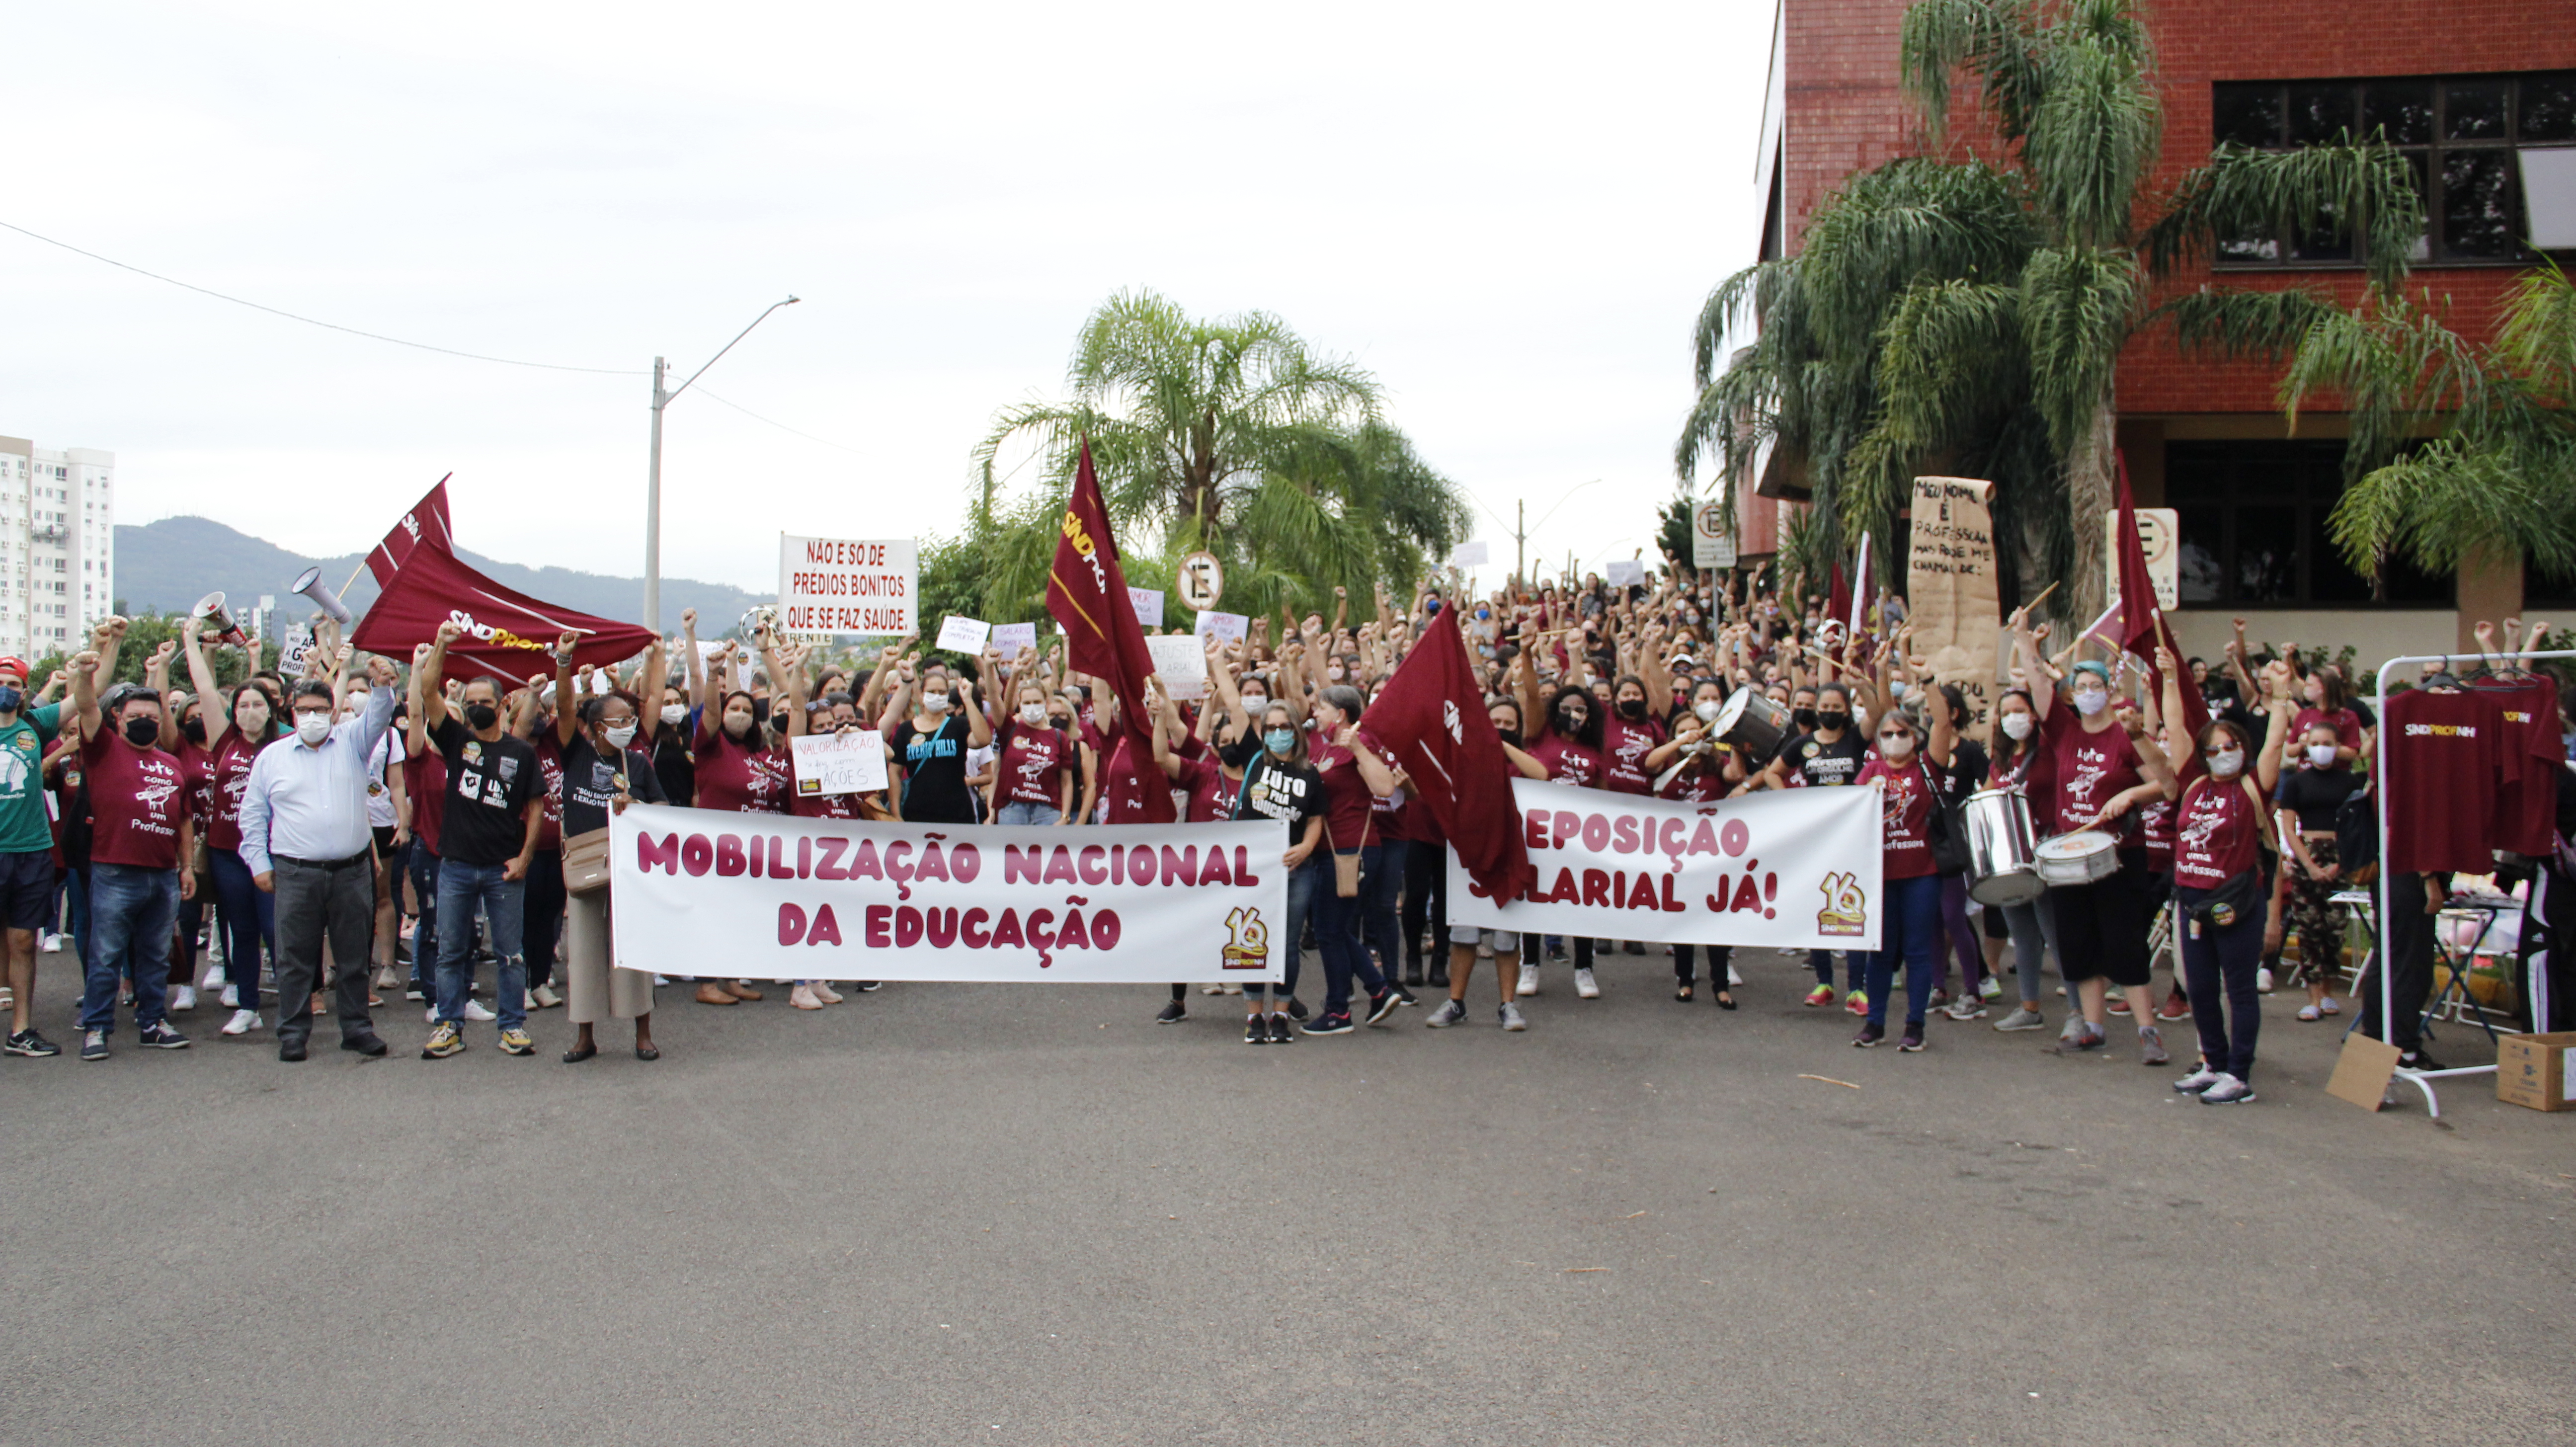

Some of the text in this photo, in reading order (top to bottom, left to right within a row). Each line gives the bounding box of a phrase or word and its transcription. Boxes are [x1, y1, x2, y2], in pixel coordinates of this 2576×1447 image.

[807, 539, 886, 566] NÃO É SÓ DE
[794, 568, 905, 597] PRÉDIOS BONITOS
[1192, 564, 1210, 598] E
[788, 604, 908, 630] QUE SE FAZ SAÚDE.
[799, 734, 876, 755] VALORIZAÇÃO
[935, 739, 957, 758] HILLS
[2077, 747, 2106, 763] Lute
[144, 775, 172, 786] como
[823, 765, 869, 787] AÇÕES
[1260, 765, 1306, 798] LUTO
[1269, 789, 1289, 805] PELA
[2072, 802, 2094, 811] uma
[150, 811, 167, 821] um
[1526, 807, 1750, 873] EPOSIÇÃO
[637, 831, 1260, 901] MOBILIZAÇÃO NACIONAL
[2186, 852, 2212, 862] uma
[1706, 858, 1777, 920] JÁ!
[1820, 871, 1864, 914] 16
[778, 895, 1121, 968] DA EDUCAÇÃO
[1224, 906, 1267, 948] 16
